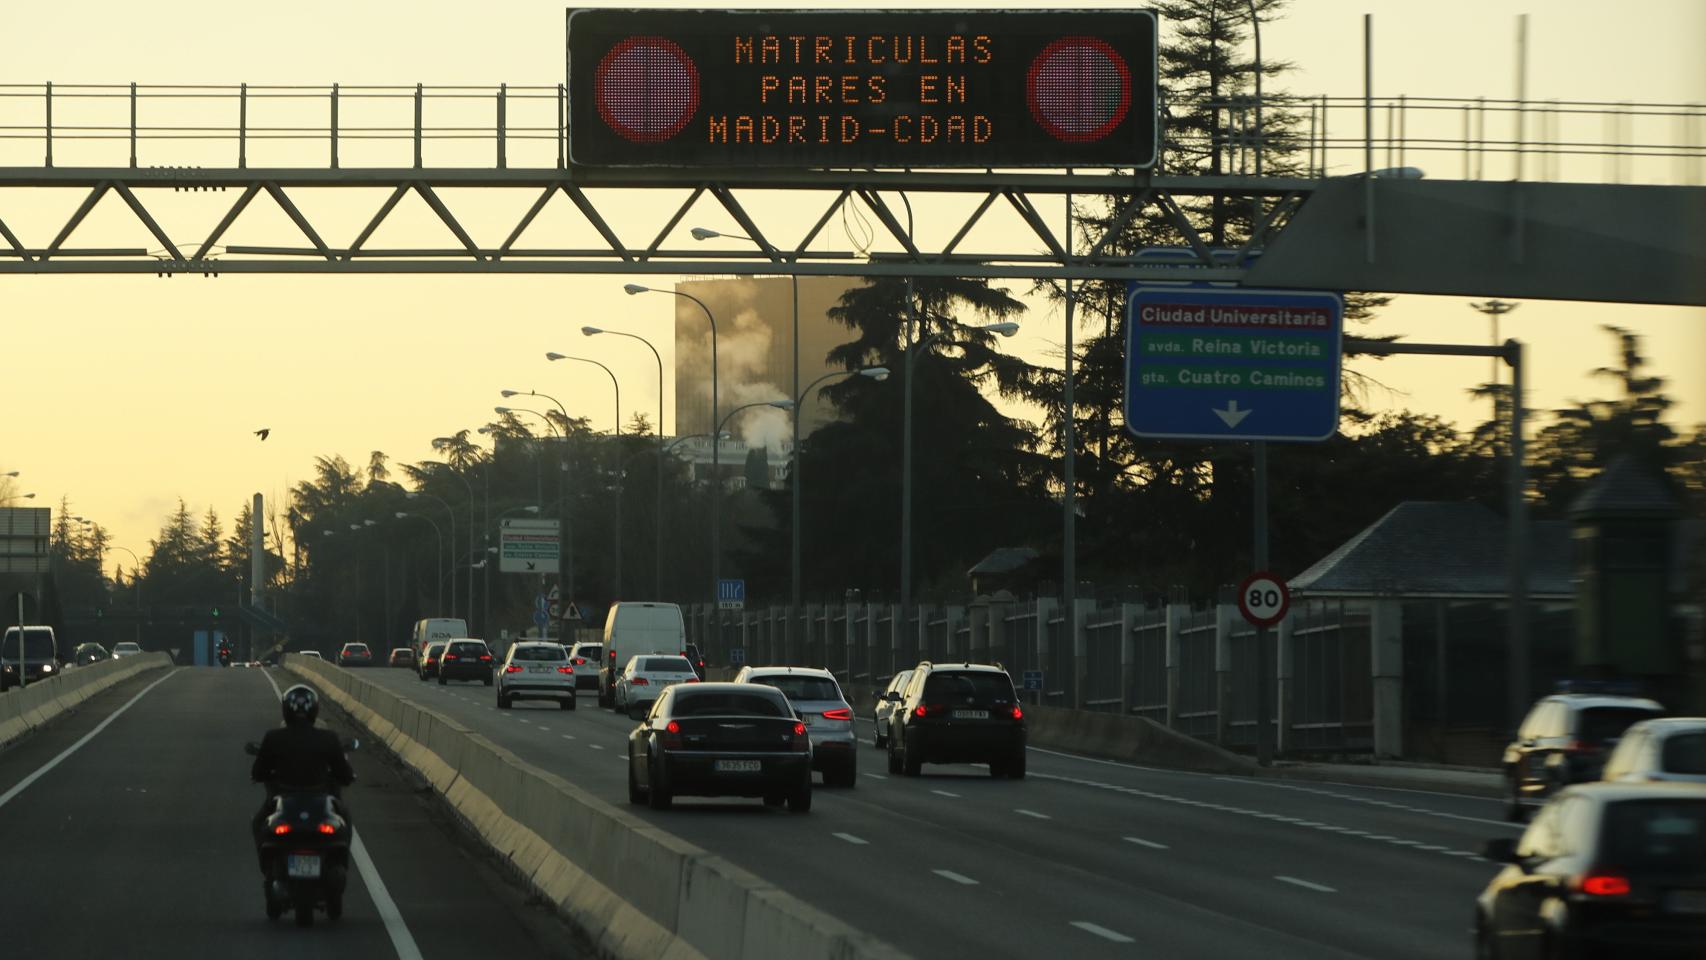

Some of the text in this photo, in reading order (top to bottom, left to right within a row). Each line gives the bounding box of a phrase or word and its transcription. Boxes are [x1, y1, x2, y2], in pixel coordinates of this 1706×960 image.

[735, 35, 992, 64] MATRICULAS
[761, 75, 967, 103] PARES EN
[708, 115, 993, 144] MADRID-CDAD
[1142, 307, 1327, 326] Ciudad Universitaria
[1148, 338, 1321, 356] avda. Reina Victoria
[1142, 369, 1325, 387] gta. Cuatro Caminos
[1250, 590, 1278, 608] 80
